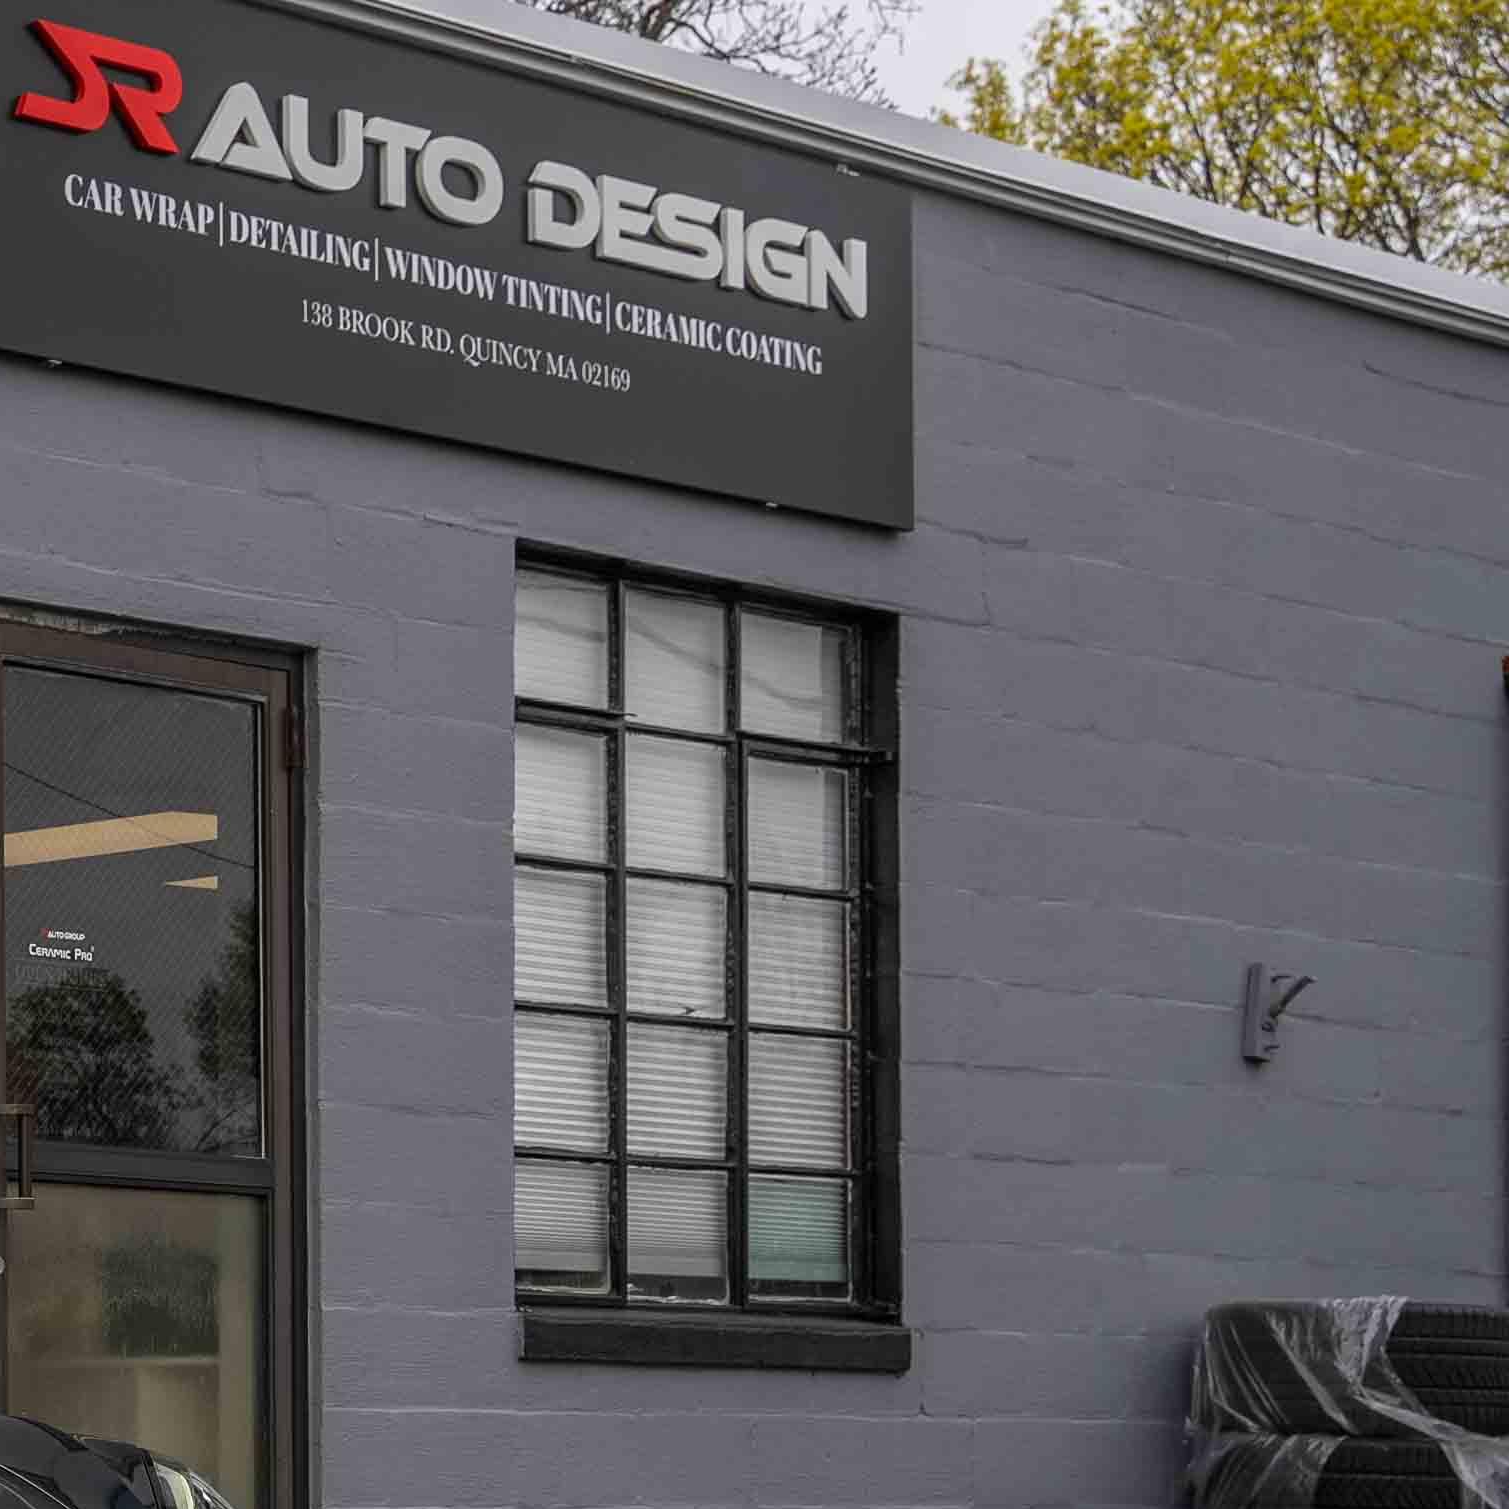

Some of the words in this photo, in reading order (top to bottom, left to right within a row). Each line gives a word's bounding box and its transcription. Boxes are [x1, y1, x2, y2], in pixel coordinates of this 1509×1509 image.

[63, 173, 125, 217] CAR
[129, 186, 215, 236] WRAP
[229, 210, 371, 273] DETAILING
[383, 246, 498, 301] WINDOW
[501, 274, 603, 326] TINTING
[614, 300, 723, 352] CERAMIC
[725, 326, 823, 375] COATING
[189, 81, 504, 226] AUTO
[526, 159, 868, 320] DESIGN
[301, 299, 333, 328] 138
[338, 306, 415, 346] BROOK
[421, 323, 456, 354] RD.
[459, 333, 542, 368] QUINCY
[546, 351, 579, 381] MA
[581, 360, 632, 392] 02169
[28, 943, 72, 960] CERAMIC
